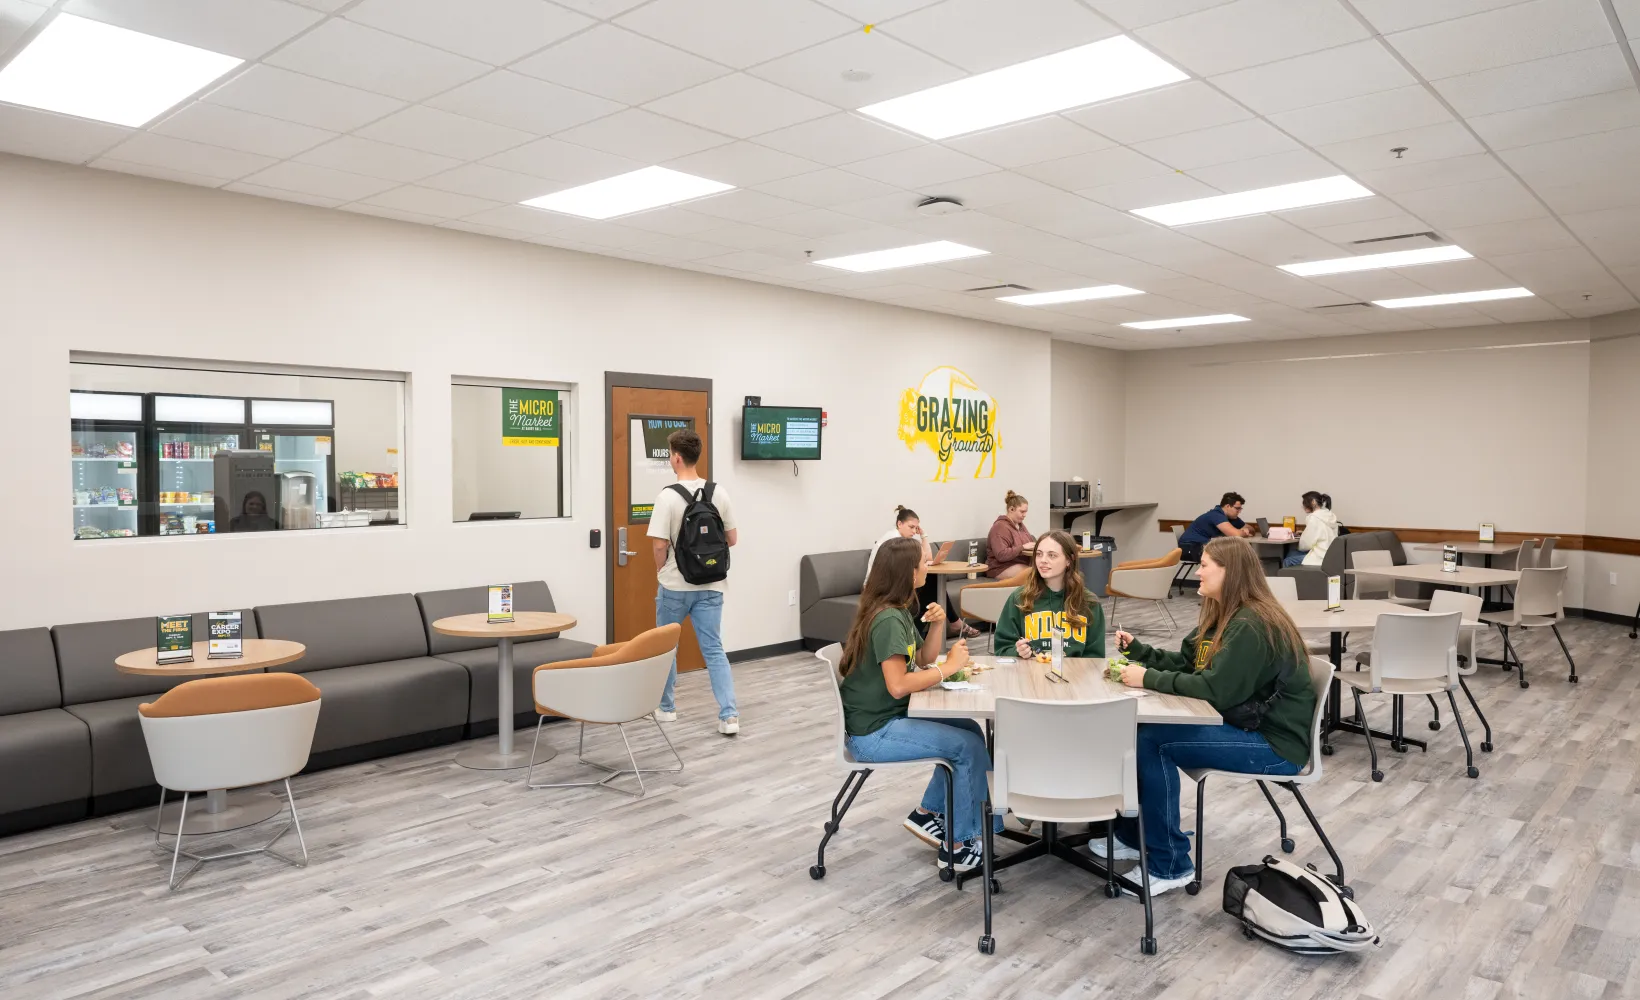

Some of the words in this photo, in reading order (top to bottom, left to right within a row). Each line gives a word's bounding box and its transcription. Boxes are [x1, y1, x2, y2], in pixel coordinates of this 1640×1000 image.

[509, 398, 518, 414] THE
[520, 400, 554, 416] MICRO
[510, 414, 552, 426] Market
[917, 396, 988, 434] GRAZING
[757, 423, 781, 434] MICRO
[750, 433, 780, 442] Market
[939, 429, 994, 462] Grounds
[652, 448, 669, 458] HOURS
[160, 620, 188, 628] MEET
